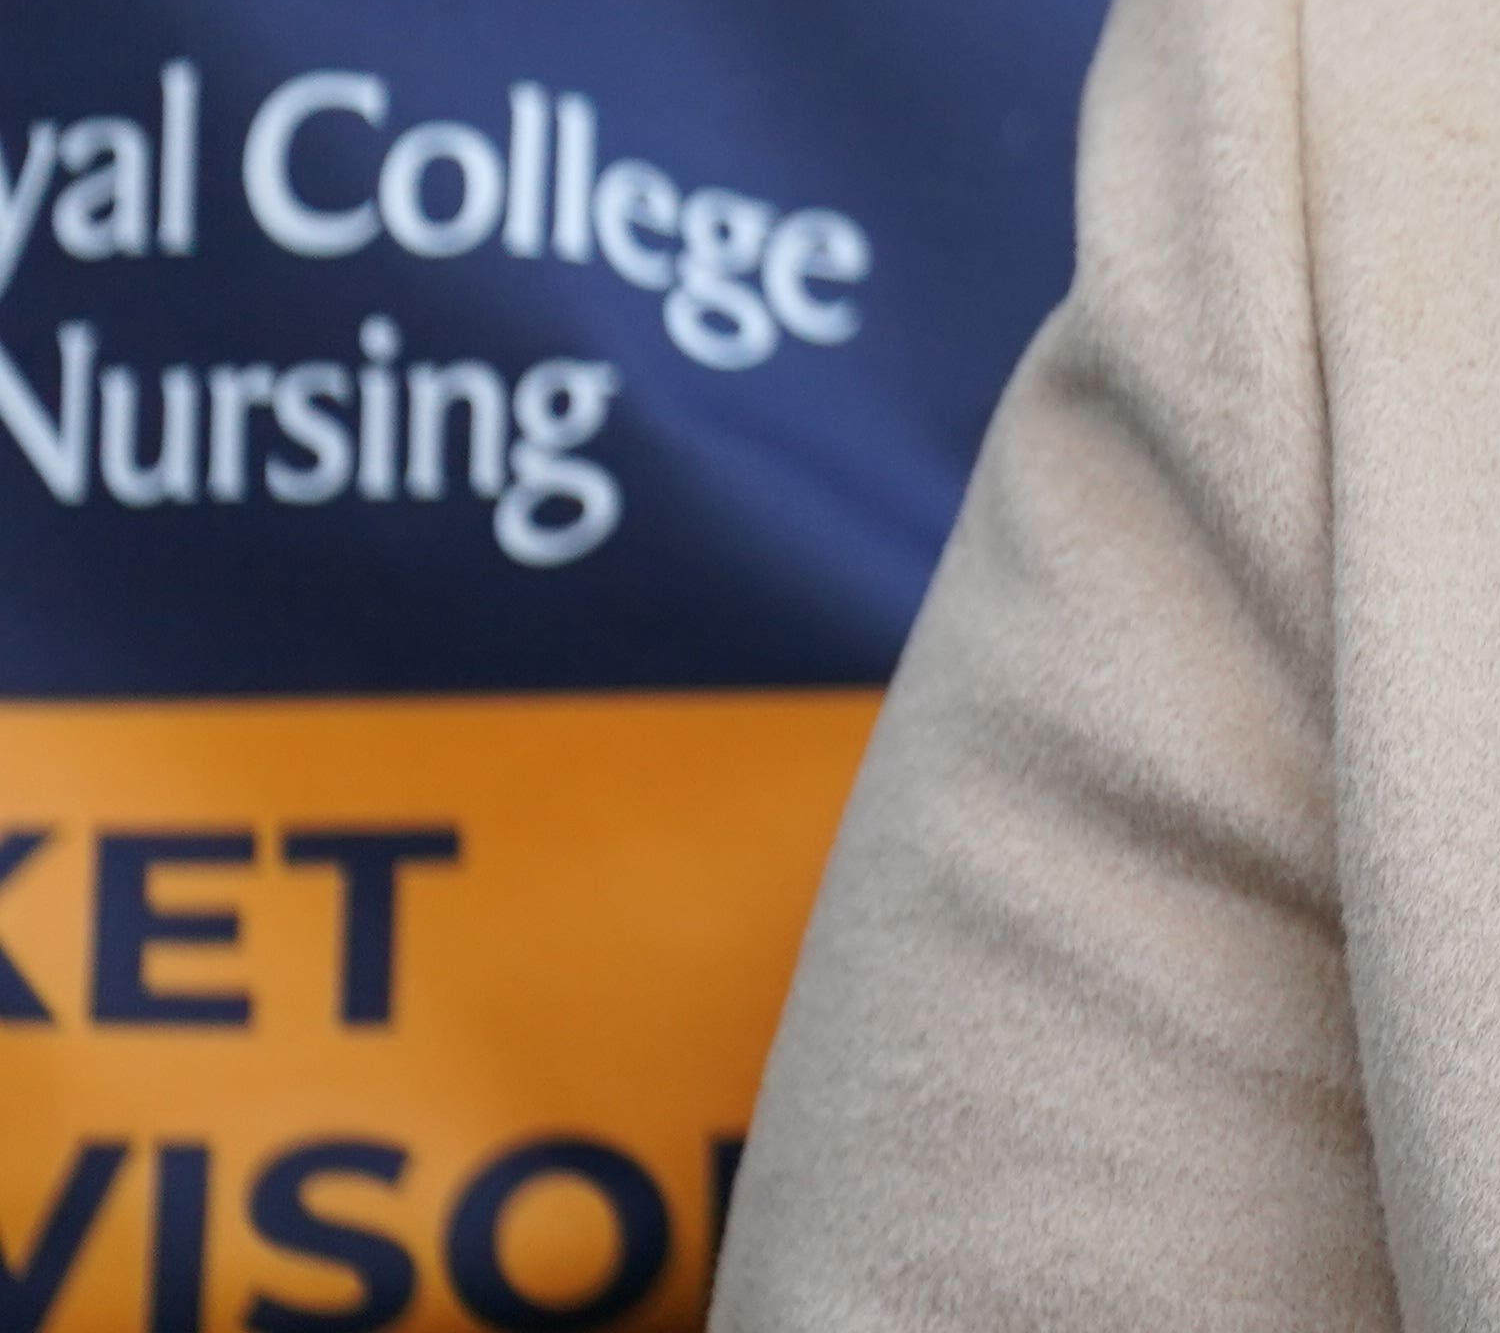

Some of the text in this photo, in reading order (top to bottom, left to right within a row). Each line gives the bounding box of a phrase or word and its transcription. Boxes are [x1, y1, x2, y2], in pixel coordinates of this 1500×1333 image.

[242, 71, 870, 369] College
[0, 319, 618, 562] Nursing
[0, 1131, 748, 1333] VISO
